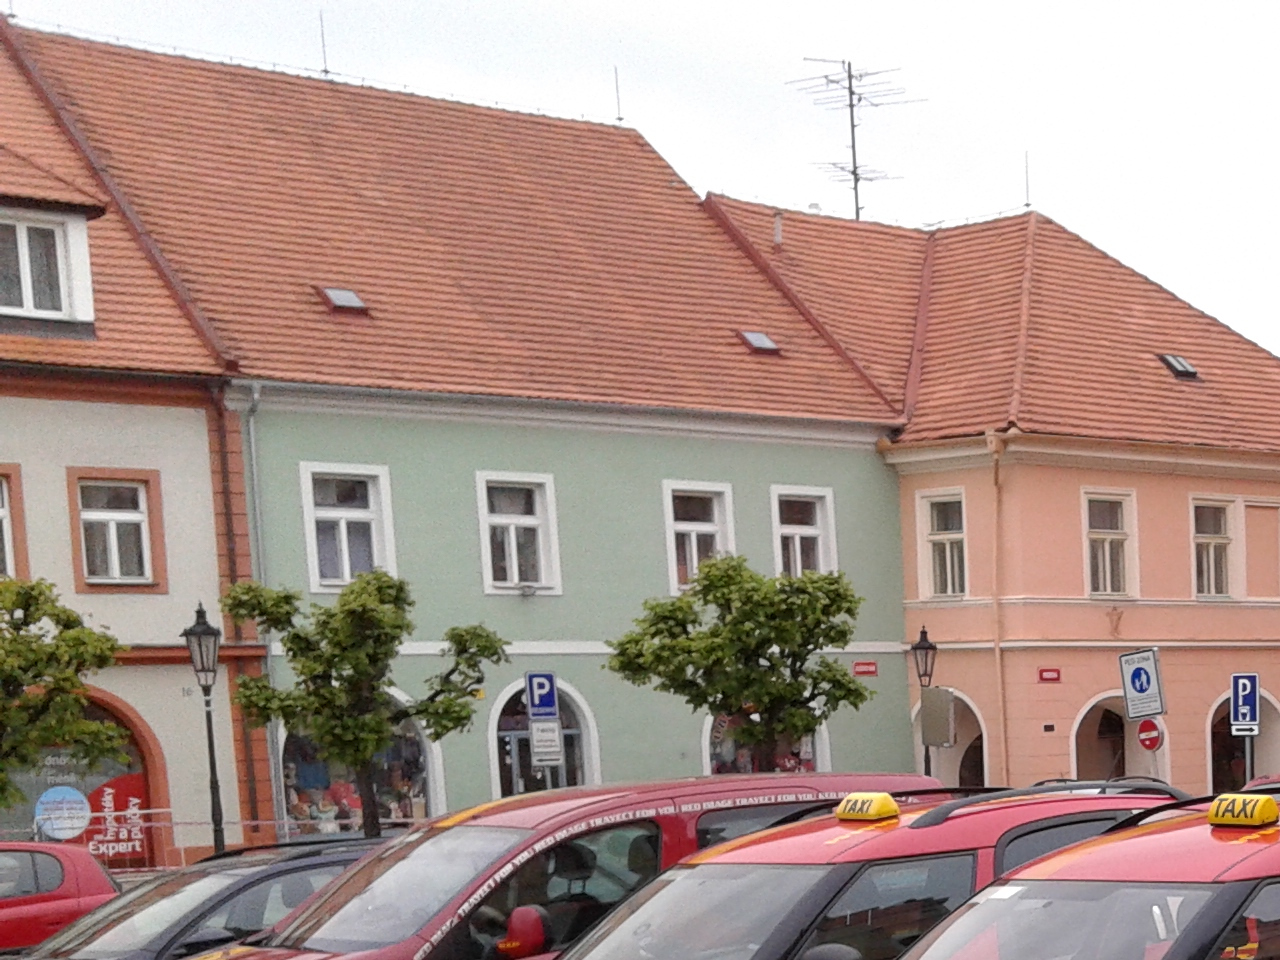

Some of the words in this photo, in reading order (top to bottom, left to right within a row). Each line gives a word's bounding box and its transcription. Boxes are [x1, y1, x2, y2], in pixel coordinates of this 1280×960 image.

[532, 677, 550, 705] P
[1238, 679, 1251, 706] P
[681, 802, 702, 814] RED
[702, 799, 734, 810] IMAGE
[777, 793, 796, 803] FOR
[841, 799, 874, 815] TAXI
[1214, 798, 1260, 819] TAXI
[88, 839, 142, 857] Expert
